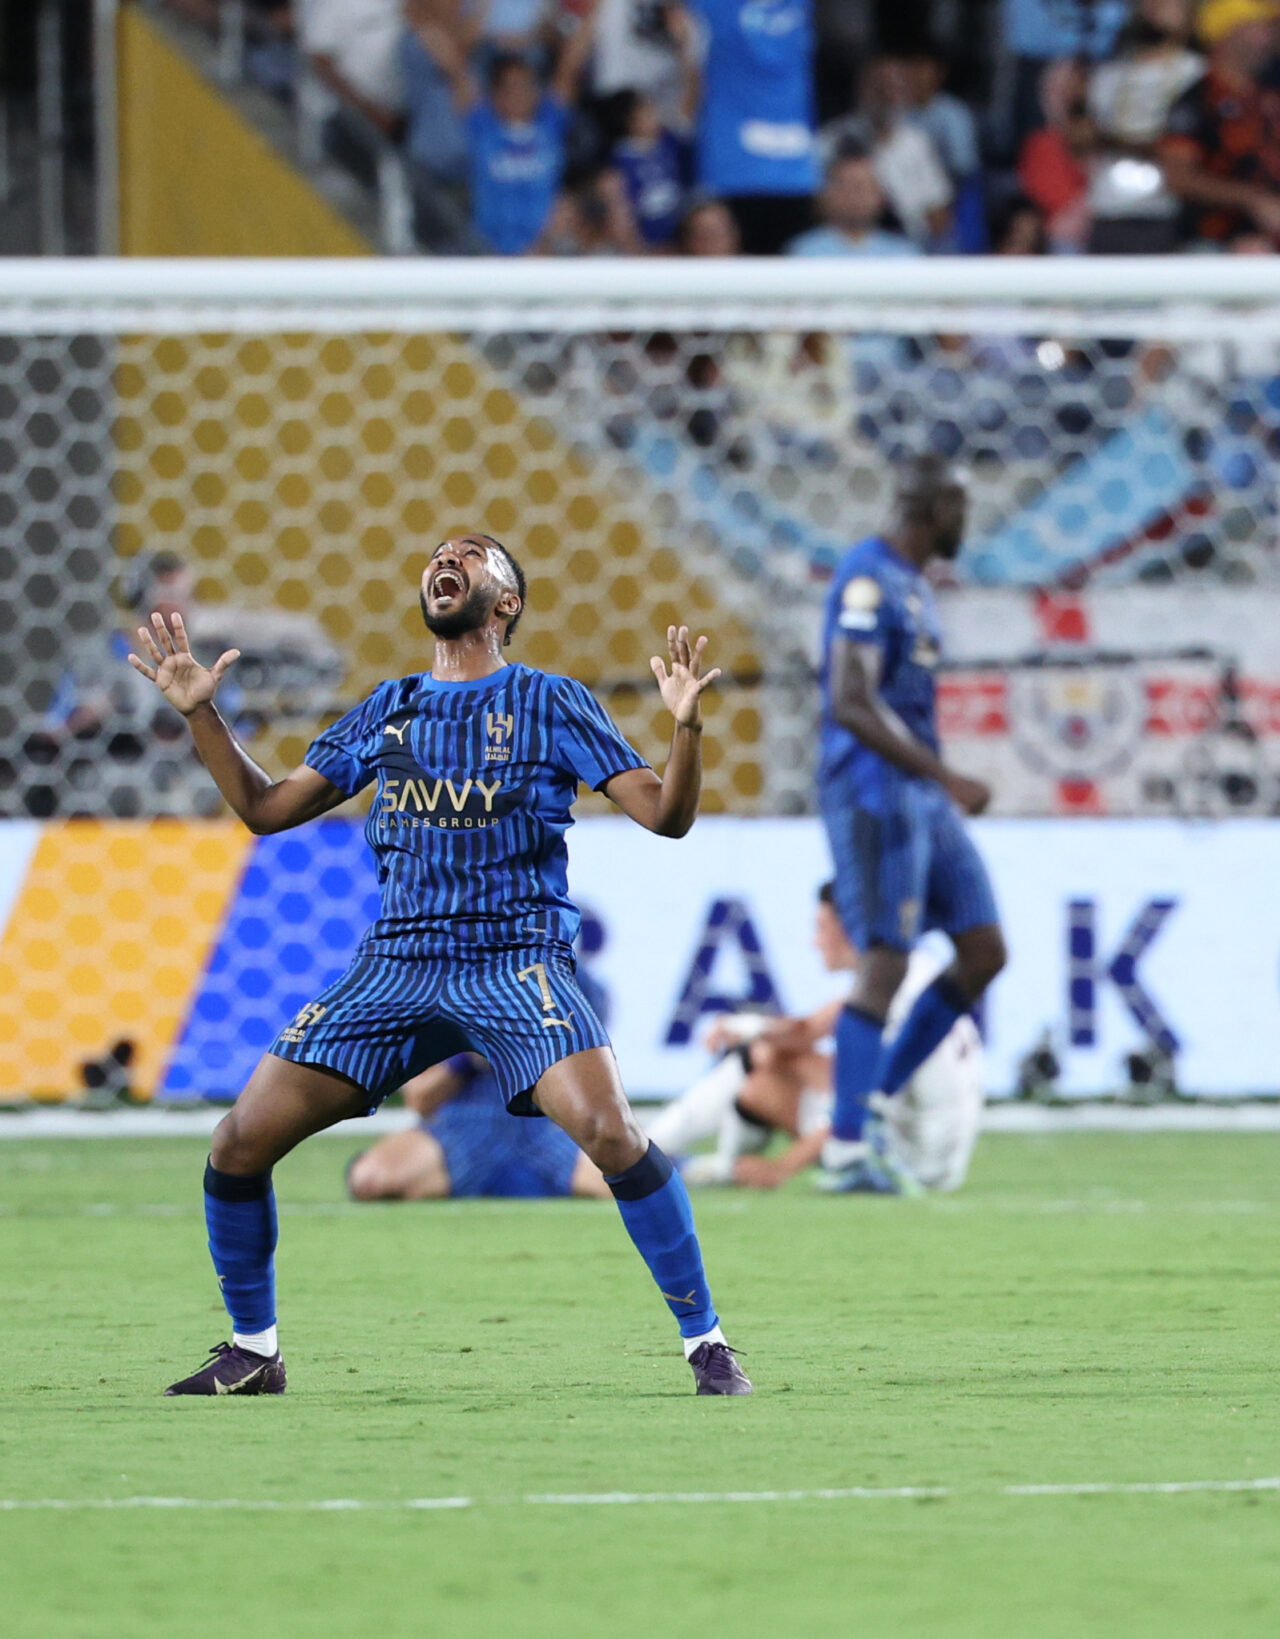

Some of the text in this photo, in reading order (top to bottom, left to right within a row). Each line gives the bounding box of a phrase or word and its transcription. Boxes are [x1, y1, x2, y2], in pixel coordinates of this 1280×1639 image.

[381, 778, 502, 813] SAVVY
[379, 817, 499, 829] GAMES GROUP
[516, 963, 556, 1011] 7
[575, 898, 1180, 1054] AK
